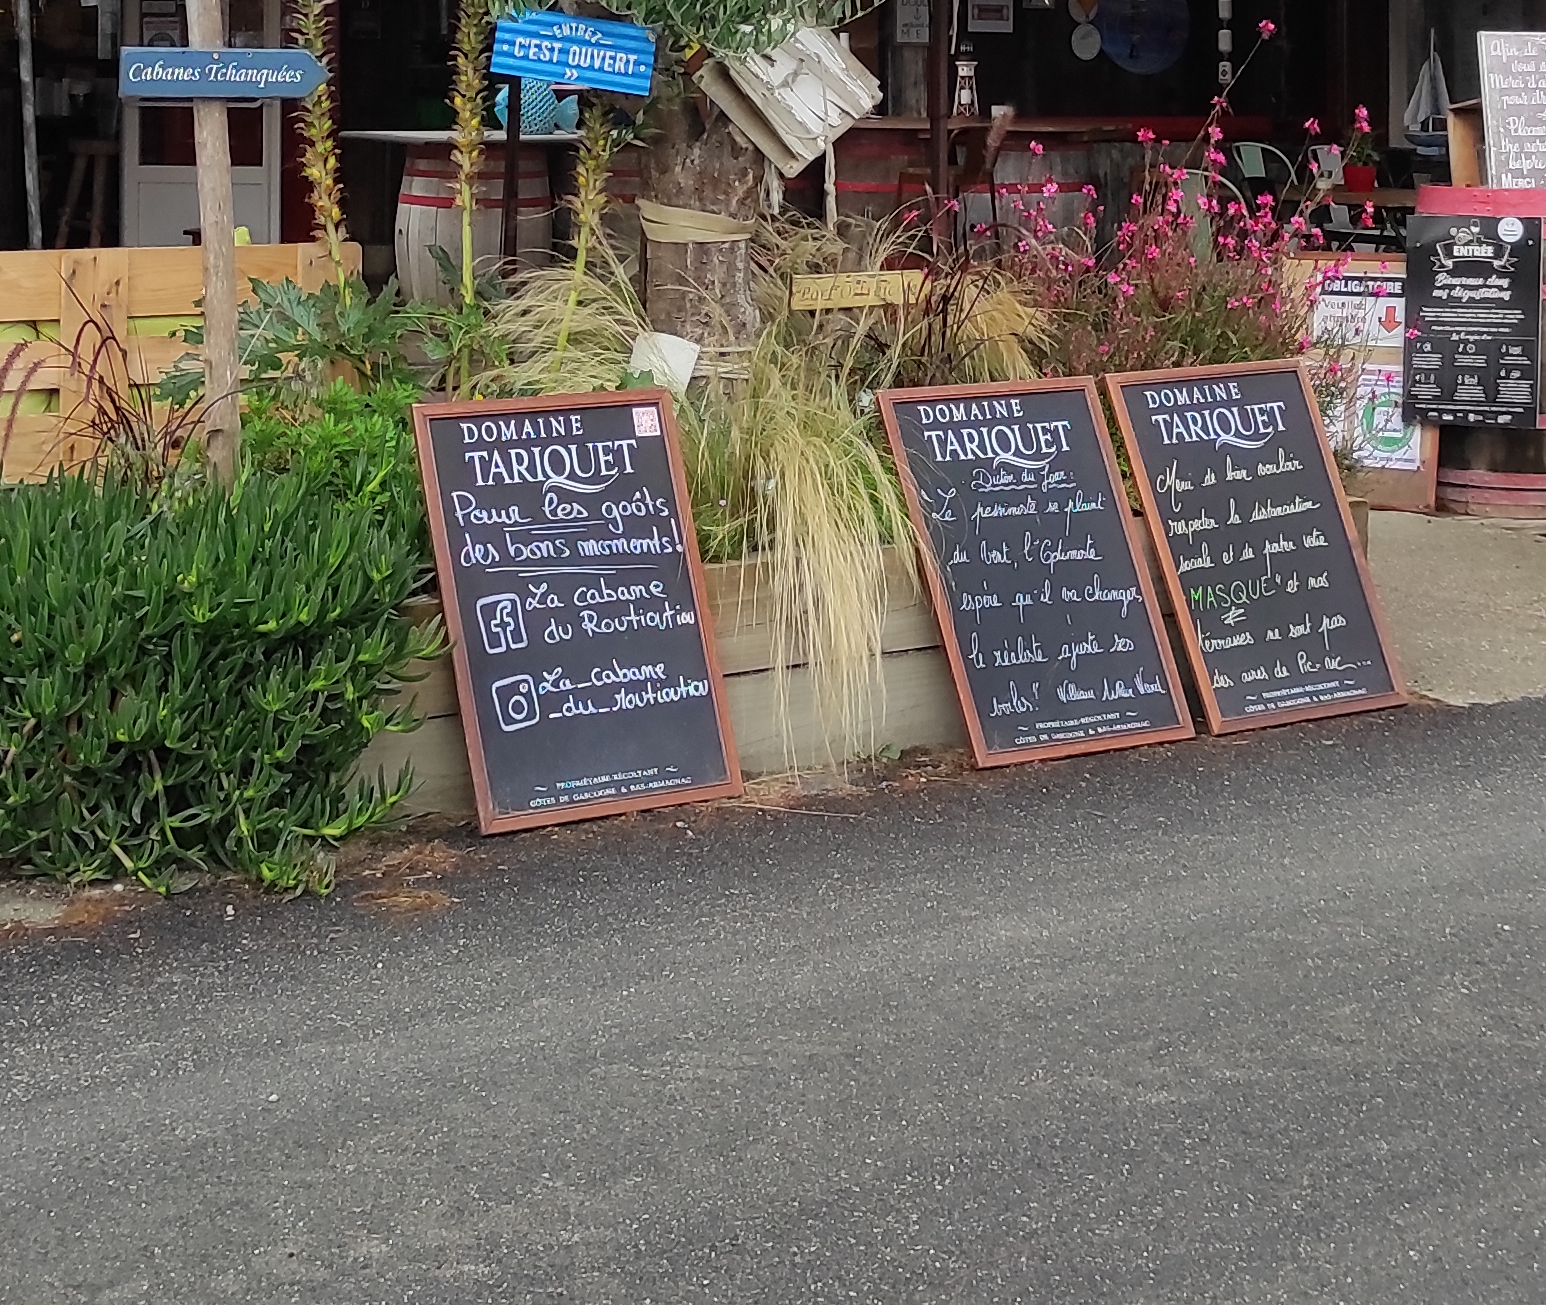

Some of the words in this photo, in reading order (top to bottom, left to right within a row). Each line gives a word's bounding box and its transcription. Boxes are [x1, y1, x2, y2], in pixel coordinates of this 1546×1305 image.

[553, 23, 603, 43] ENTREZ
[514, 35, 562, 63] C'EST
[568, 46, 637, 74] OUVERT
[129, 60, 201, 82] Cabanes
[205, 62, 304, 87] Tchanquées
[1453, 244, 1494, 257] ENTRÉE
[1143, 382, 1241, 408] DOMAINE
[917, 398, 1024, 424] DOMAINE
[459, 414, 583, 444] DOMAINE
[1151, 401, 1287, 451] TARIQUET
[924, 420, 1071, 469] TARIQUET
[464, 438, 639, 495] TARIQUET
[450, 491, 532, 527] Pour
[541, 493, 589, 521] les
[601, 487, 670, 534] goûts
[459, 531, 500, 567] des
[505, 533, 571, 562] bons
[1222, 546, 1235, 565] et
[525, 582, 564, 611] La
[573, 577, 668, 607] cabane
[1285, 571, 1300, 593] et
[543, 617, 572, 644] du
